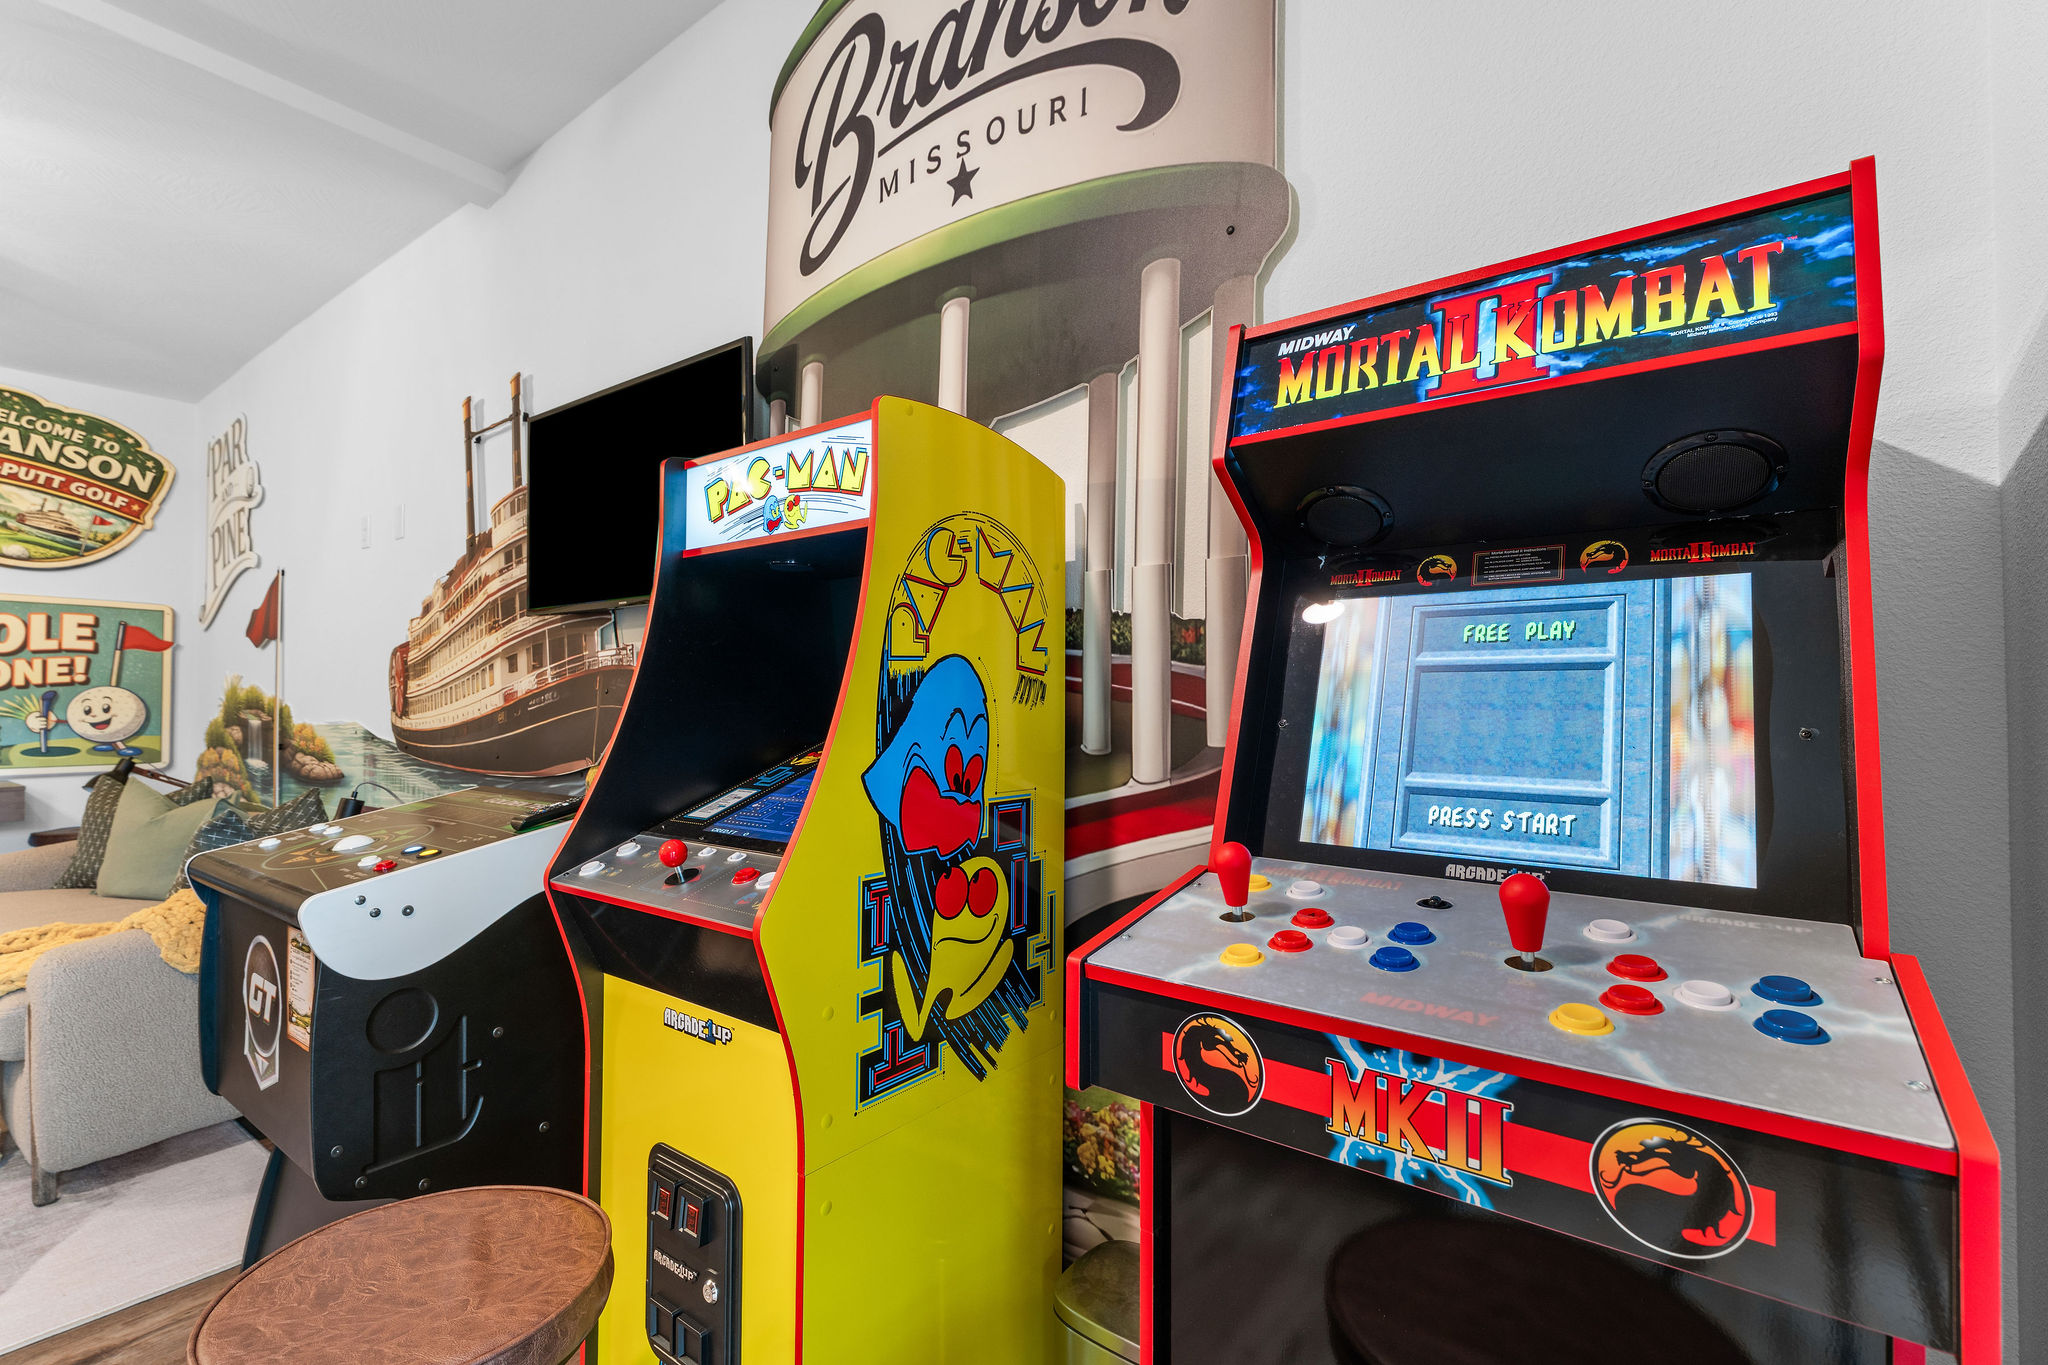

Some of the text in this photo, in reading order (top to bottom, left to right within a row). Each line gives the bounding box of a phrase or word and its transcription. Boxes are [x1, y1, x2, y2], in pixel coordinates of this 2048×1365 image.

[879, 87, 1089, 204] MISSOURI
[1273, 314, 1482, 410] MORTAL
[1489, 240, 1785, 365] KOMBAT
[1278, 325, 1356, 356] MIDWAY
[1687, 316, 1778, 338] Midway Manufacturing Company
[0, 407, 120, 454] ELCOME TO
[0, 426, 156, 493] ANSON
[211, 418, 244, 500] PAR
[69, 481, 129, 509] GOLF
[704, 445, 870, 524] PAC-MAN
[211, 507, 247, 591] PINE
[1649, 546, 1700, 562] MORTAL
[1701, 541, 1757, 558] KOMBAT
[887, 524, 1049, 676] PAC-MAN
[0, 612, 98, 656] OLE
[1463, 620, 1577, 643] FREE PLAY
[711, 827, 739, 835] CREDIT
[1428, 805, 1577, 837] PRESS START
[249, 972, 278, 1025] GT
[1359, 992, 1499, 1027] MIDWAY
